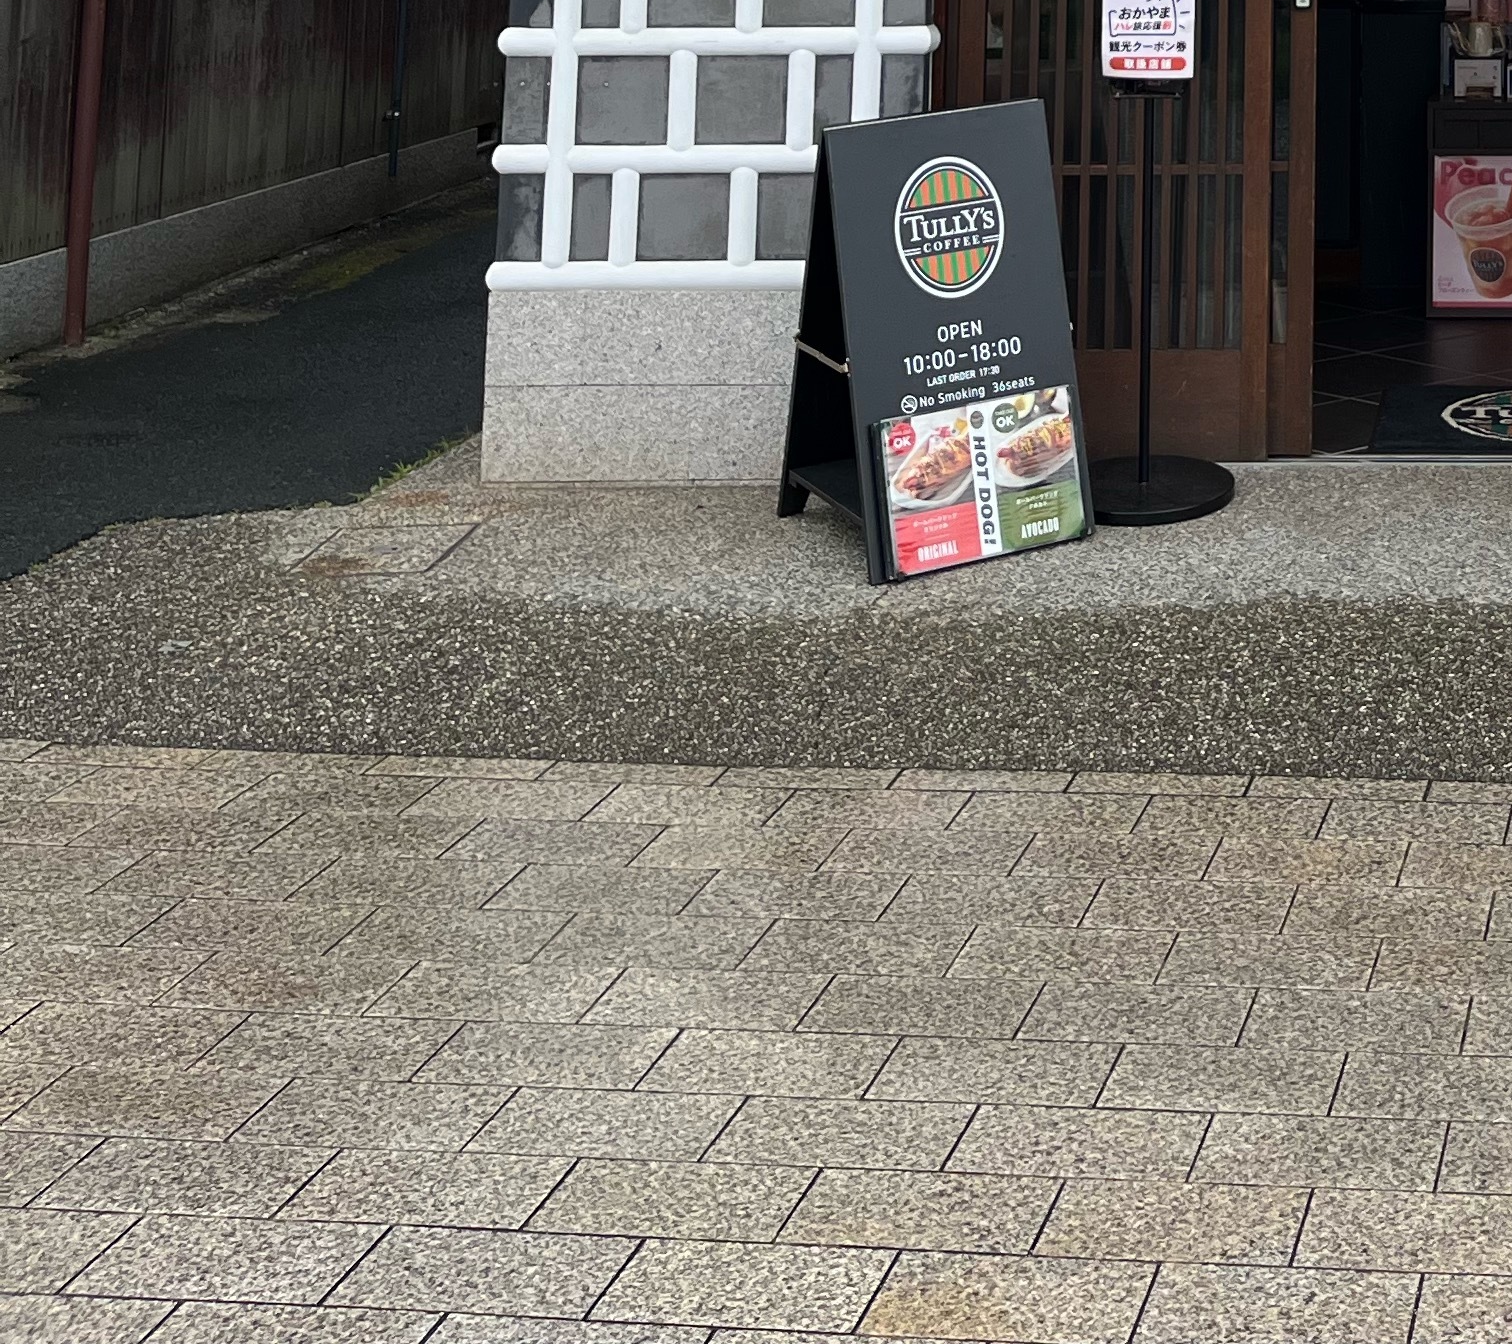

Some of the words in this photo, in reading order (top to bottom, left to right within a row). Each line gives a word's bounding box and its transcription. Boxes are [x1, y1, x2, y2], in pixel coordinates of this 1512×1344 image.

[1118, 6, 1171, 20] おかやま
[1108, 40, 1187, 53] 観光クーポン券
[903, 206, 996, 242] TULLY'S
[923, 234, 981, 253] COFFEE
[937, 319, 983, 343] OPEN
[926, 375, 948, 387] LAST
[948, 370, 977, 383] ORDER
[919, 395, 935, 408] No
[937, 386, 986, 405] Smoking
[996, 414, 1016, 429] OK
[893, 434, 913, 450] OK
[973, 435, 990, 481] HOT
[1021, 516, 1060, 540] AVOCADO
[917, 539, 960, 563] ORIGINAL
